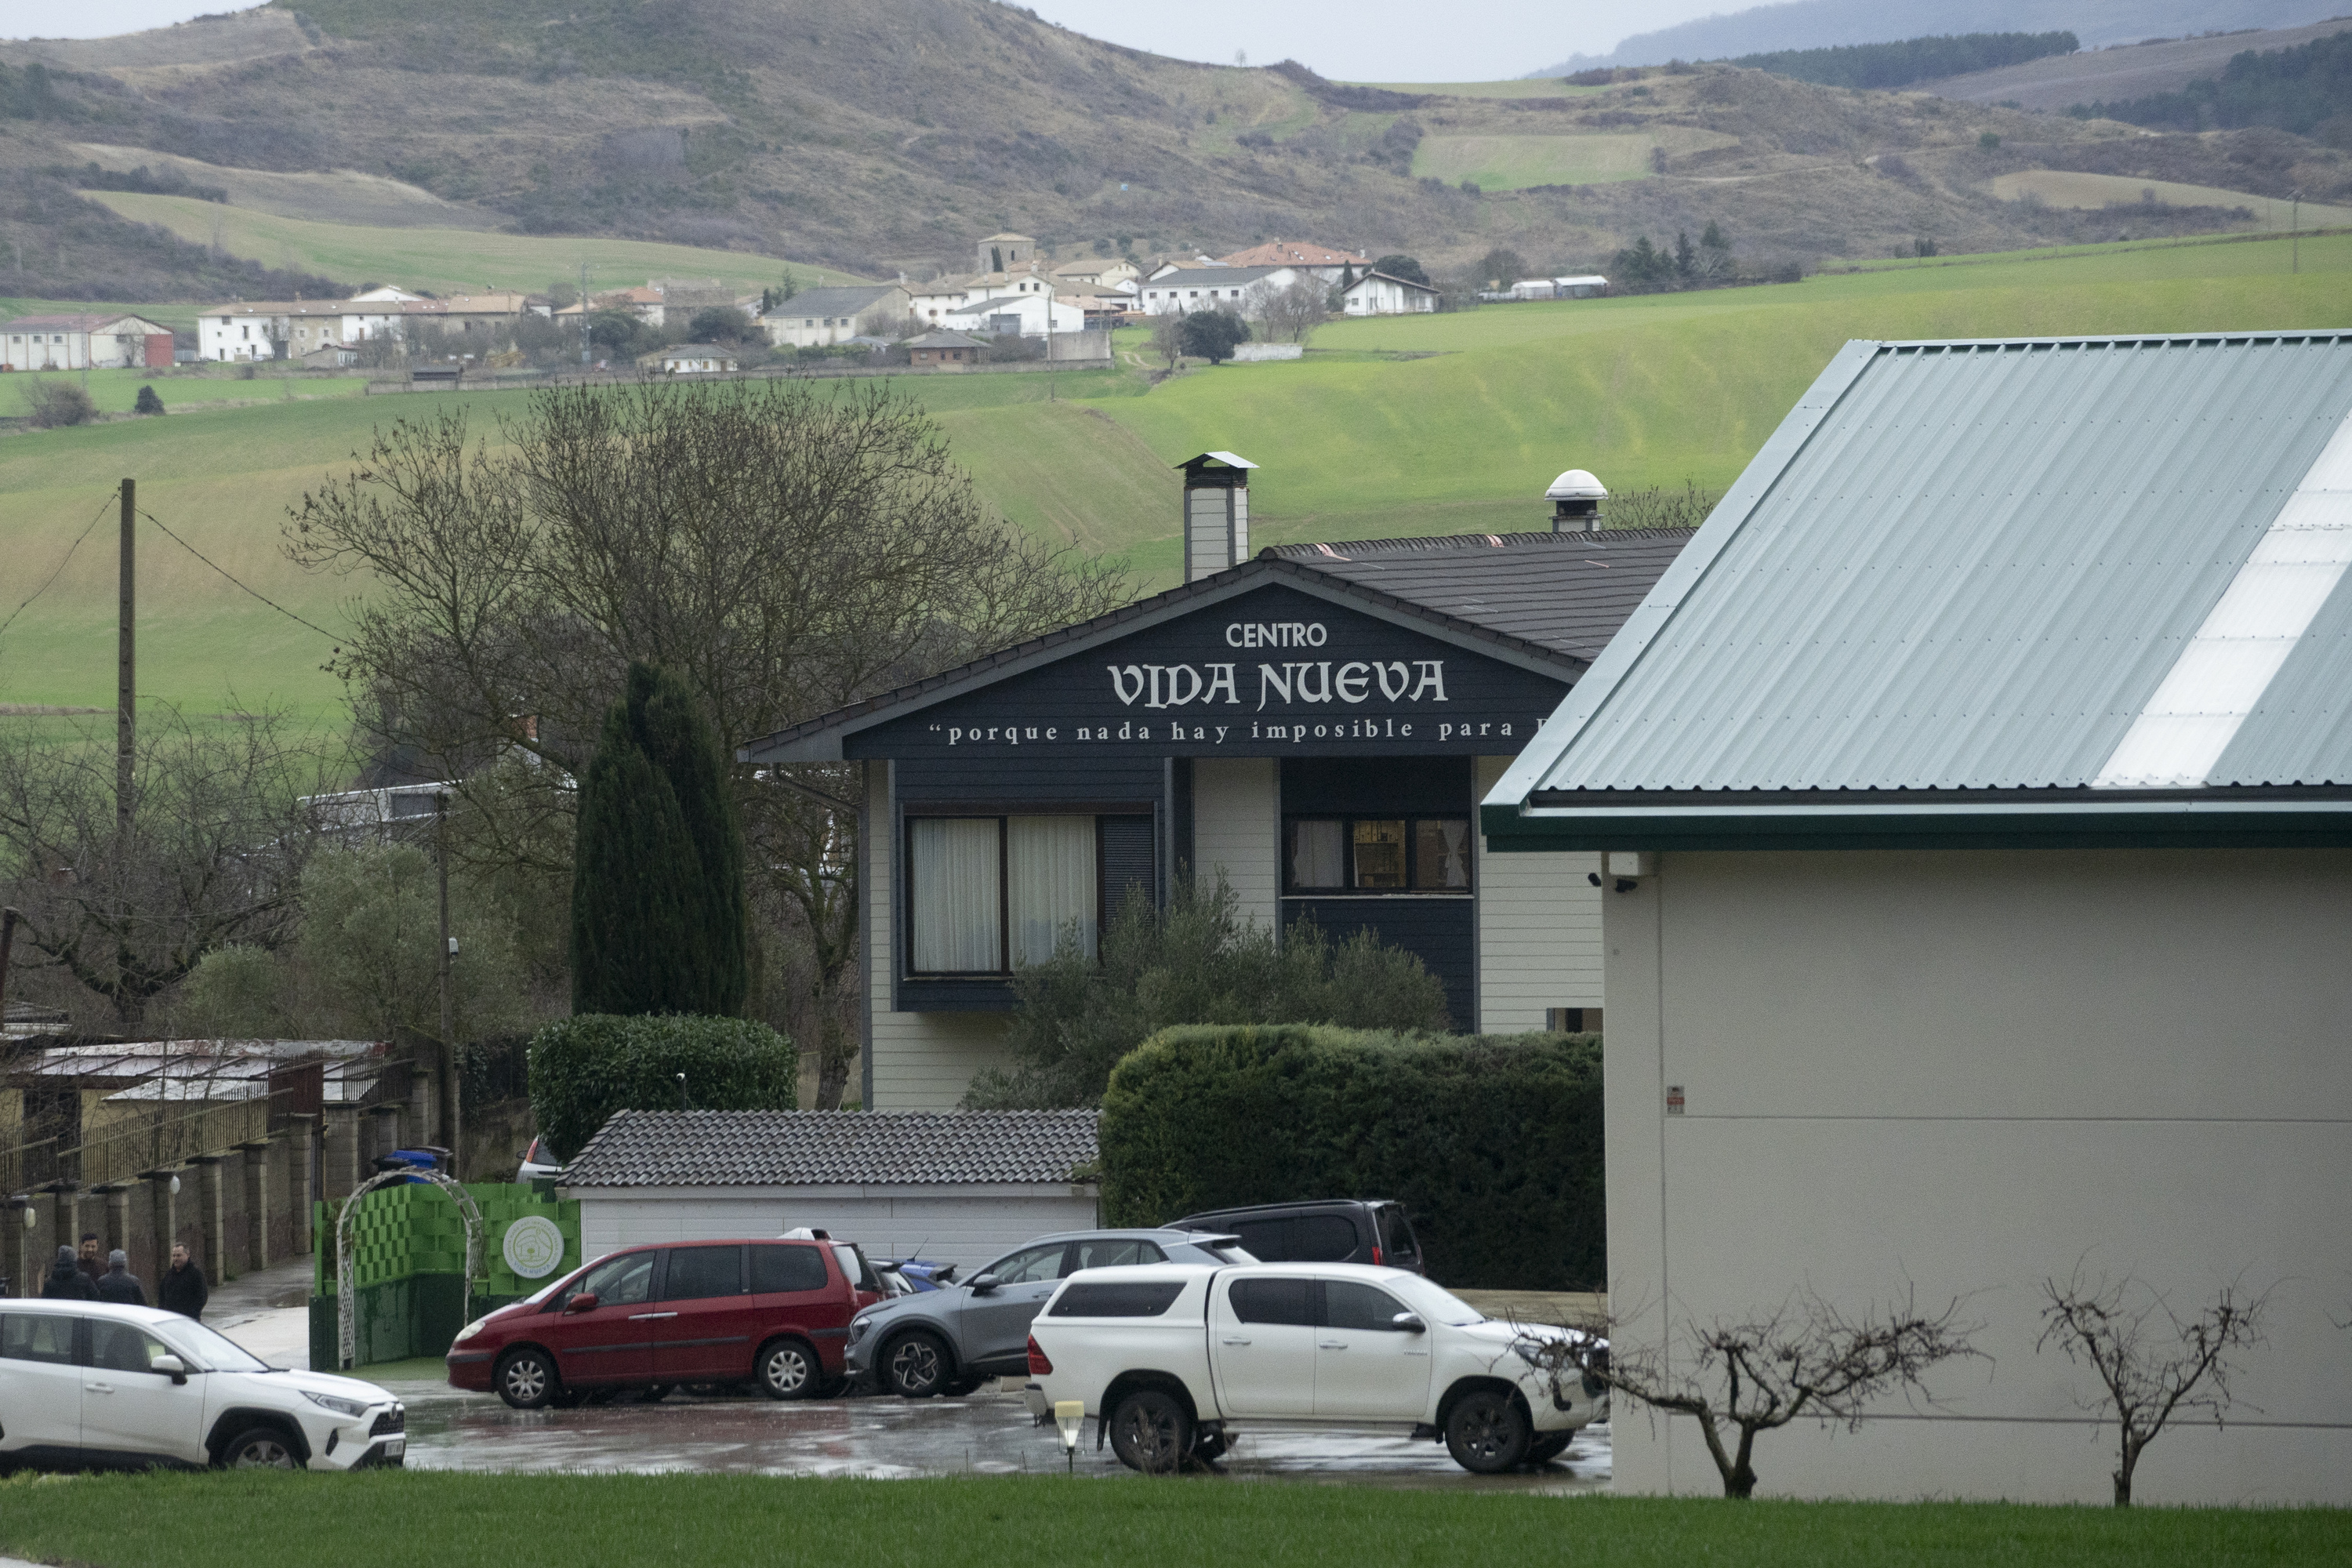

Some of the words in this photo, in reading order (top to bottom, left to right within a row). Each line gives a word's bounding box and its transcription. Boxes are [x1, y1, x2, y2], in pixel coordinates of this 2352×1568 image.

[1225, 622, 1327, 648] CENTRO
[1106, 663, 1241, 710] VIDA
[1257, 660, 1449, 713] NUEVA
[1076, 721, 1150, 740] nada
[1171, 722, 1229, 744] hay
[1252, 718, 1412, 743] imposible
[1439, 723, 1512, 742] para
